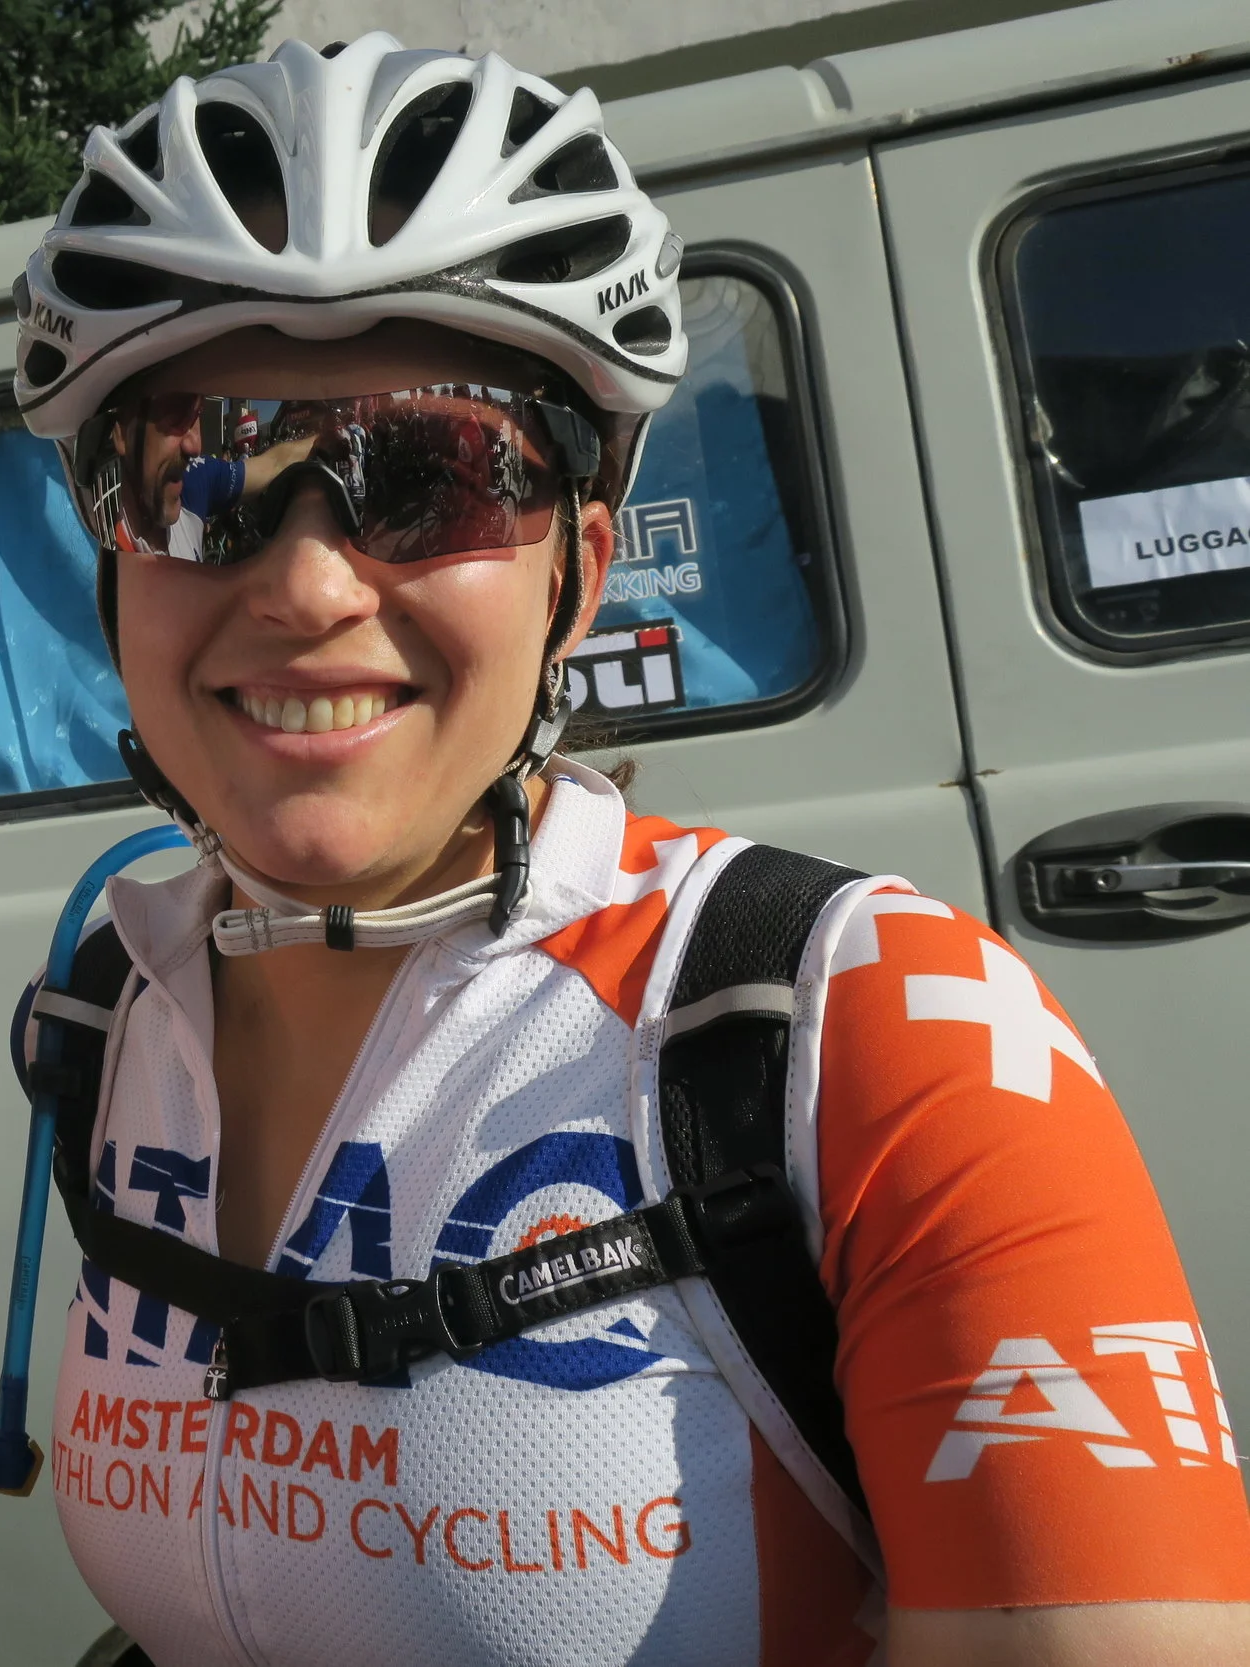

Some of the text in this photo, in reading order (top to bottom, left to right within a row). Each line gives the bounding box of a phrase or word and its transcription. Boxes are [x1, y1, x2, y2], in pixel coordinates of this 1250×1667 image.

[34, 302, 74, 343] KASK
[597, 268, 650, 315] KASK
[1135, 527, 1250, 560] LUGGA
[500, 1236, 642, 1305] CAMELBAK
[924, 1320, 1239, 1483] AT
[70, 1389, 400, 1486] AMSTERDAM
[52, 1436, 692, 1573] THLON AND CYCLING
